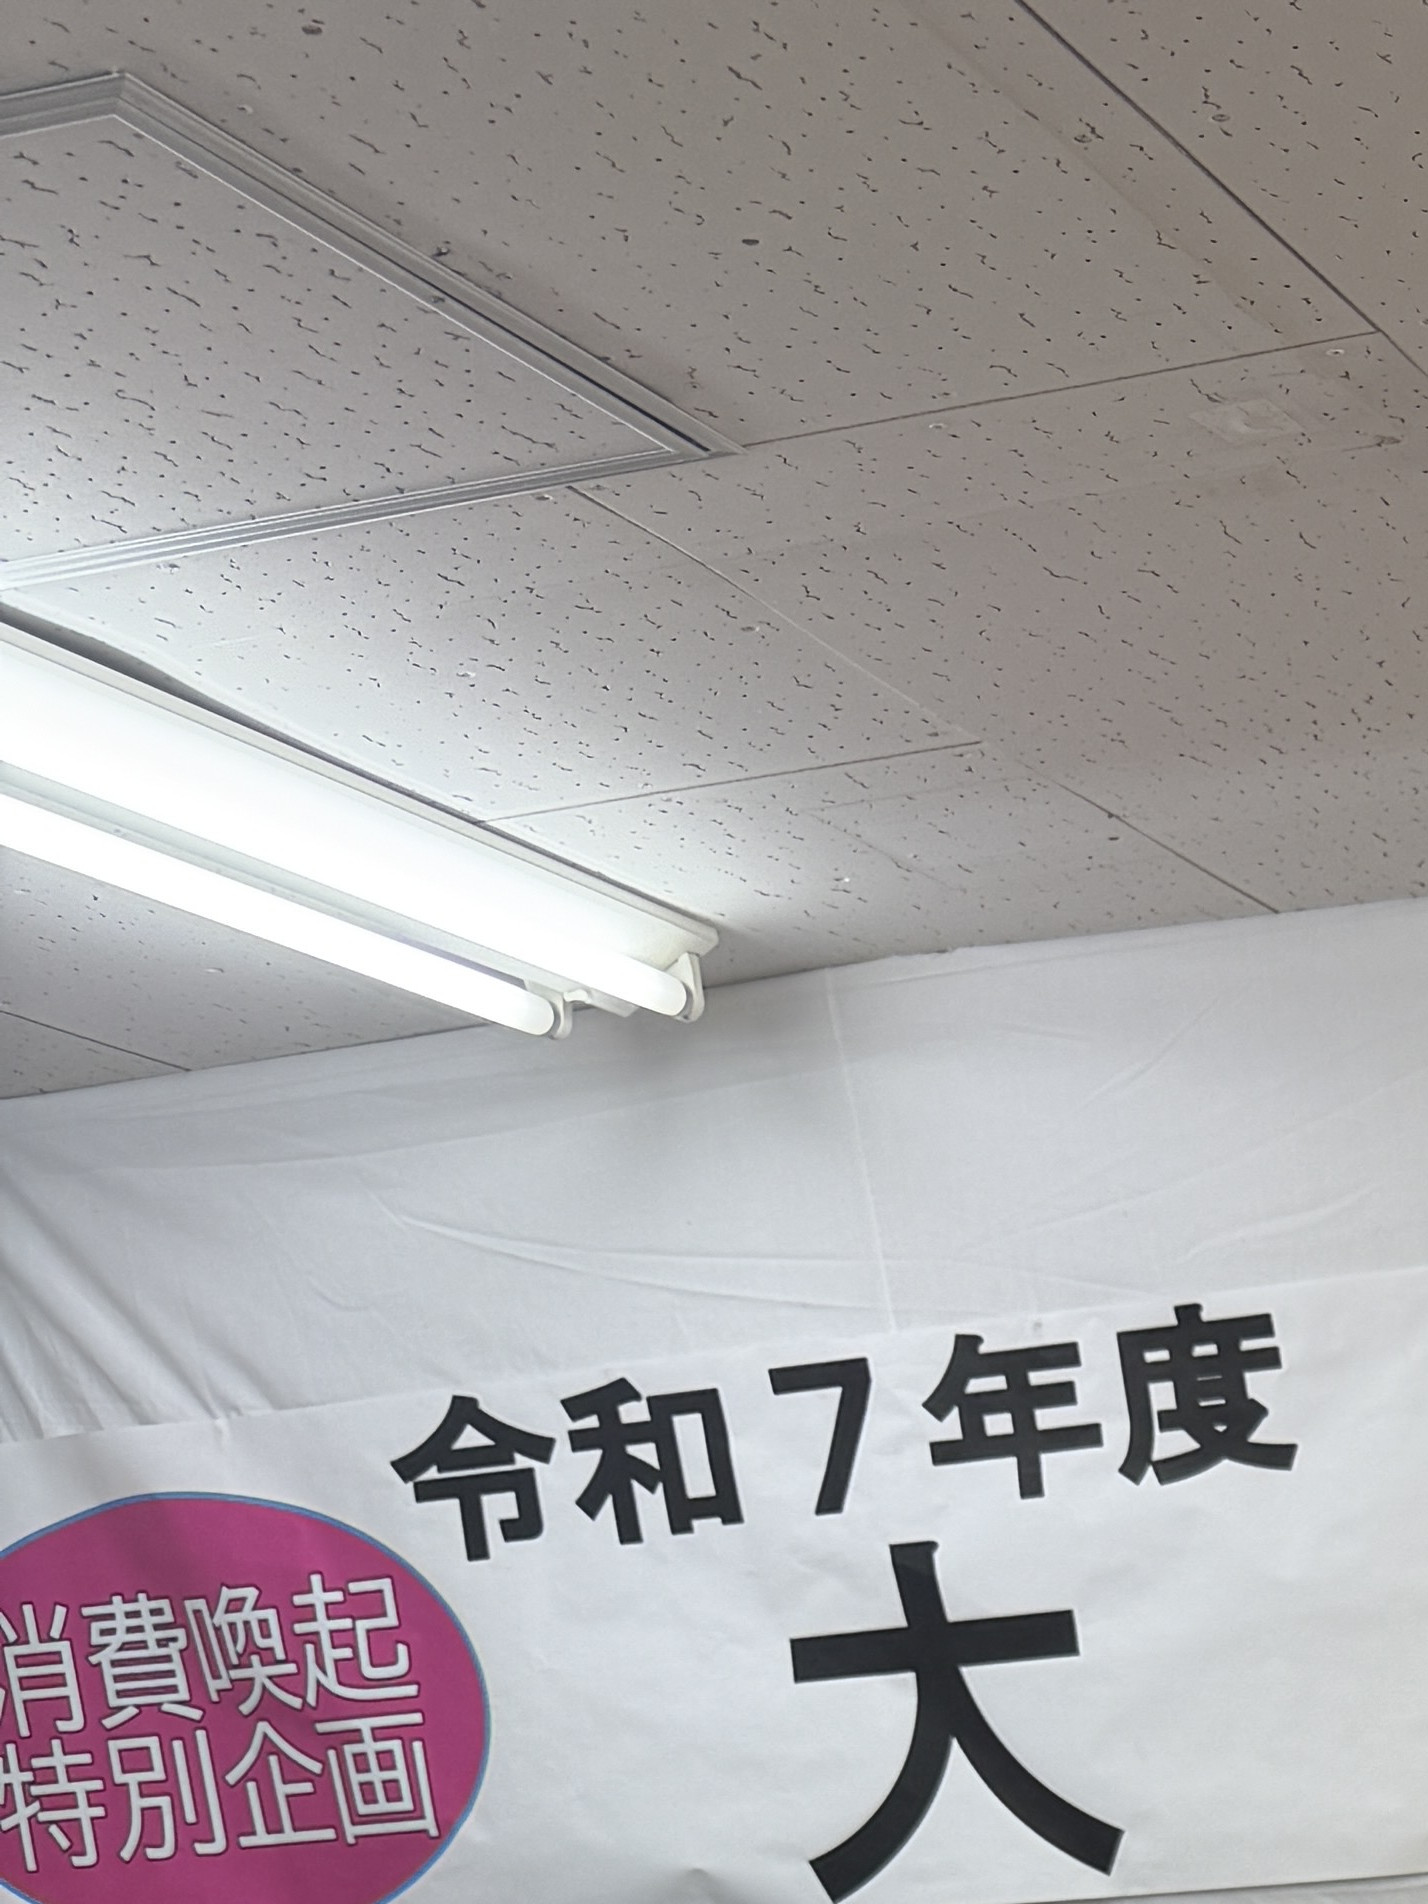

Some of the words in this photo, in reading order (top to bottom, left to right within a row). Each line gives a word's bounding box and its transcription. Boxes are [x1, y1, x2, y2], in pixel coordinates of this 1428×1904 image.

[388, 1302, 1298, 1564] 令和7年度
[0, 1572, 420, 1738] 消費喚起
[0, 1713, 438, 1873] 特別企画
